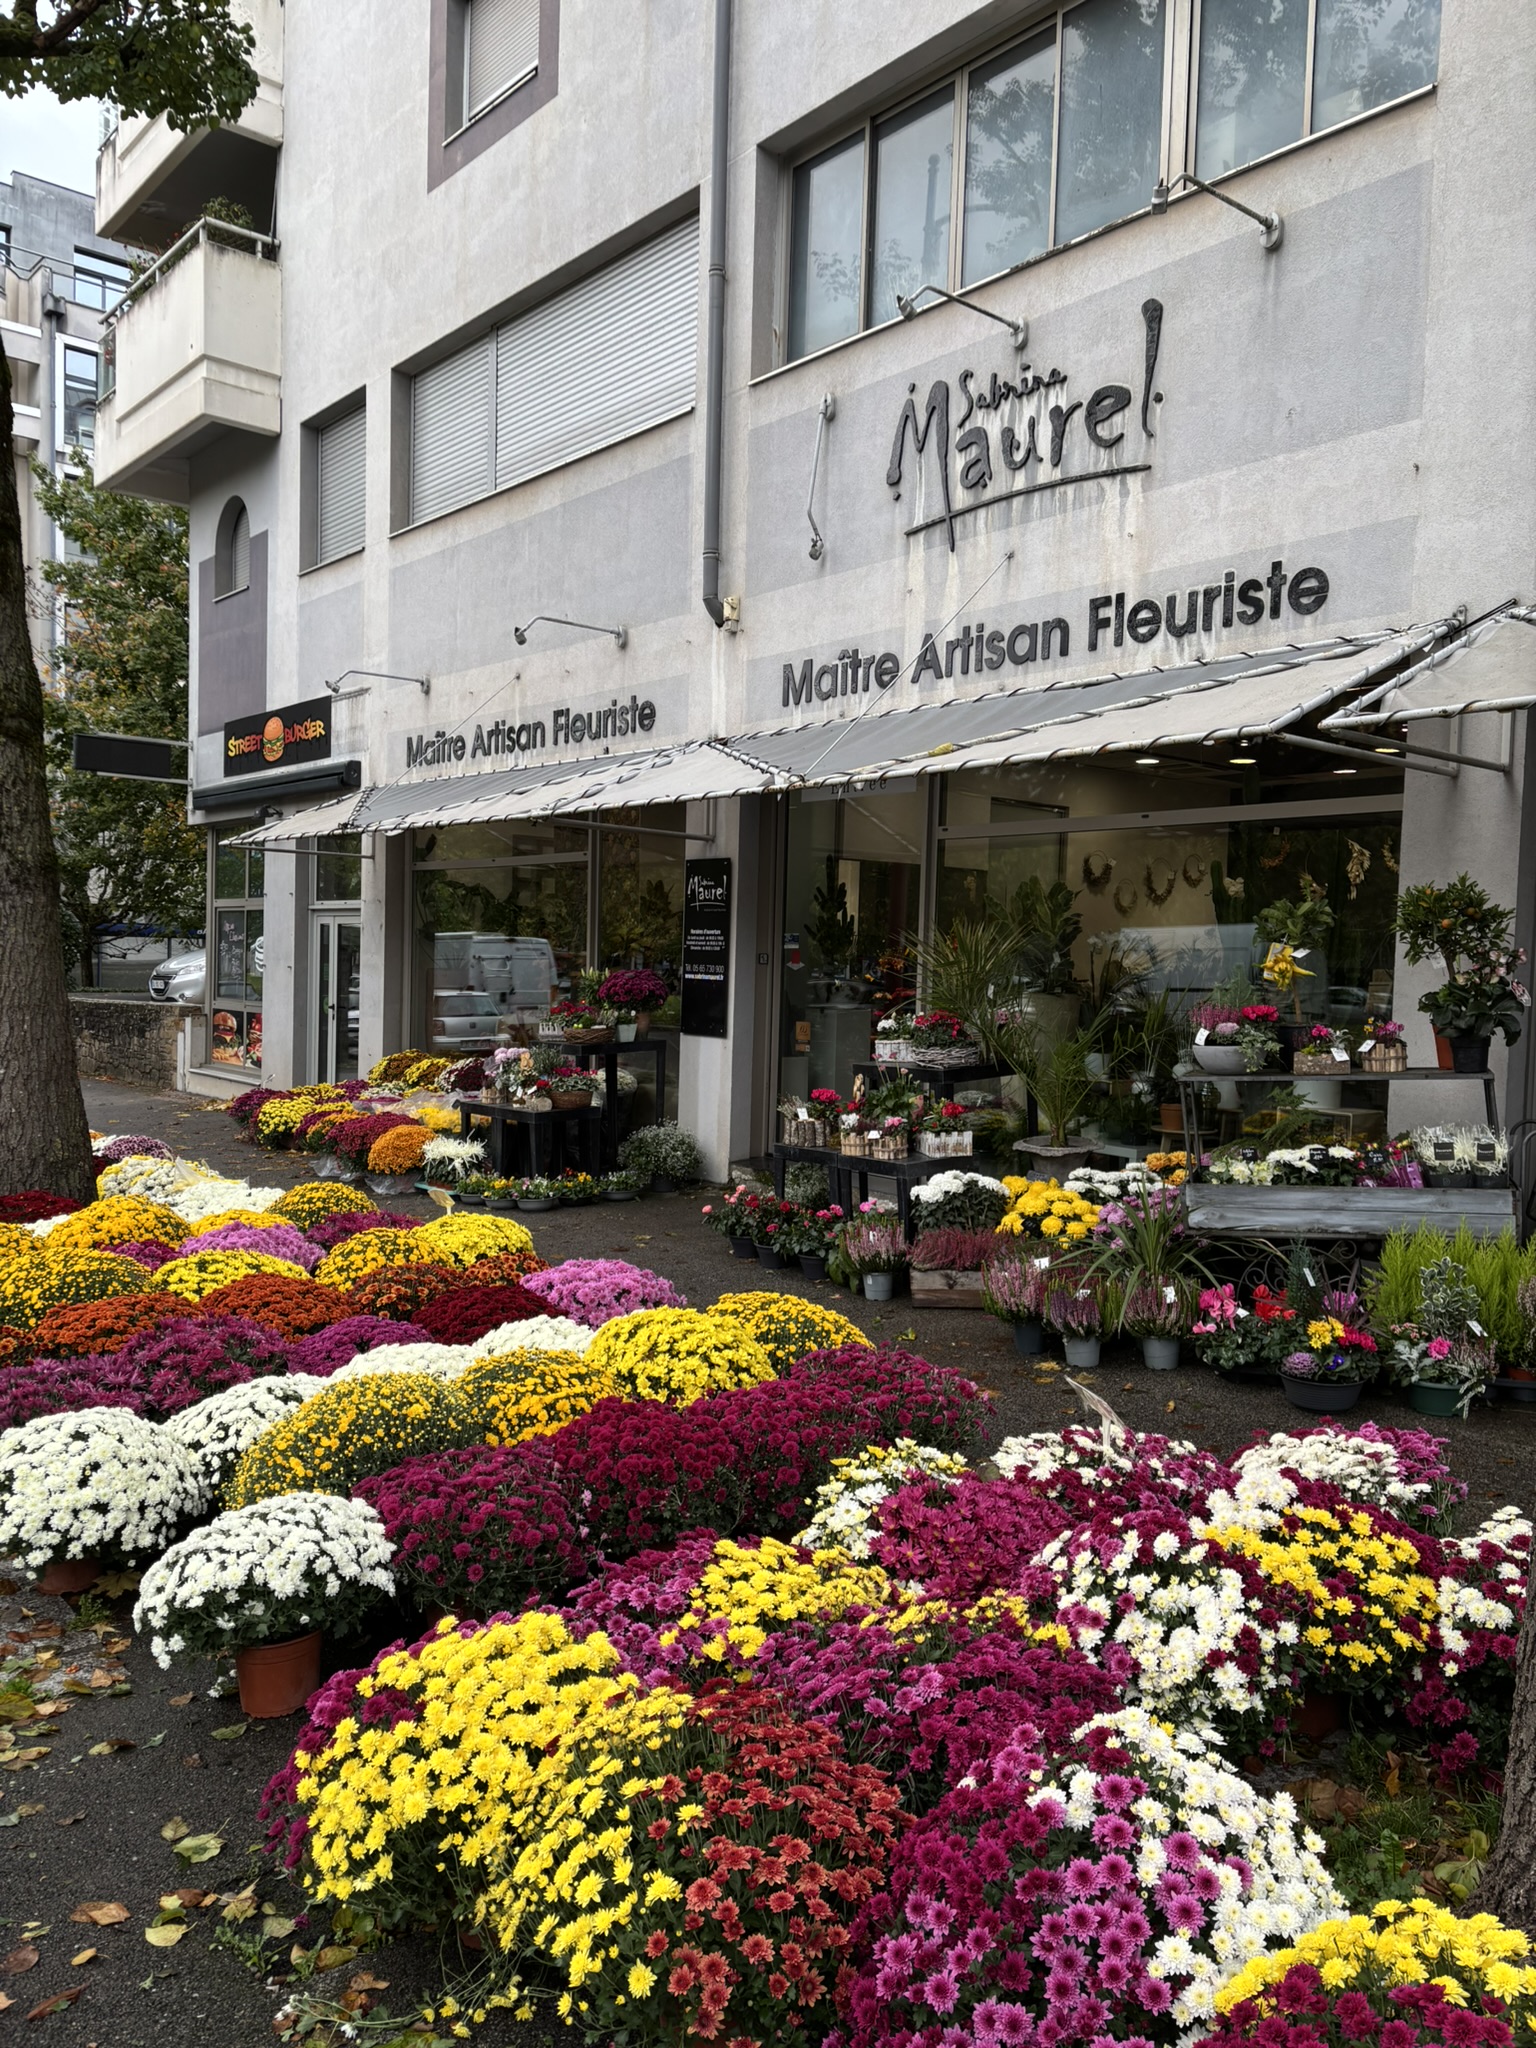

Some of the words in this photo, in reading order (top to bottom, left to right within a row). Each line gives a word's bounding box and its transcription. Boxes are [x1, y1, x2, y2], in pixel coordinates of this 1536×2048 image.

[956, 362, 1067, 429] Sabrina
[782, 648, 901, 707] Maître
[911, 616, 1070, 683] Artisan
[1088, 560, 1330, 651] Fleuriste
[227, 733, 263, 757] STREET
[284, 717, 326, 744] BURGER
[406, 730, 466, 768] Maître
[471, 720, 546, 759] Artisan
[553, 695, 657, 746] Fleuriste
